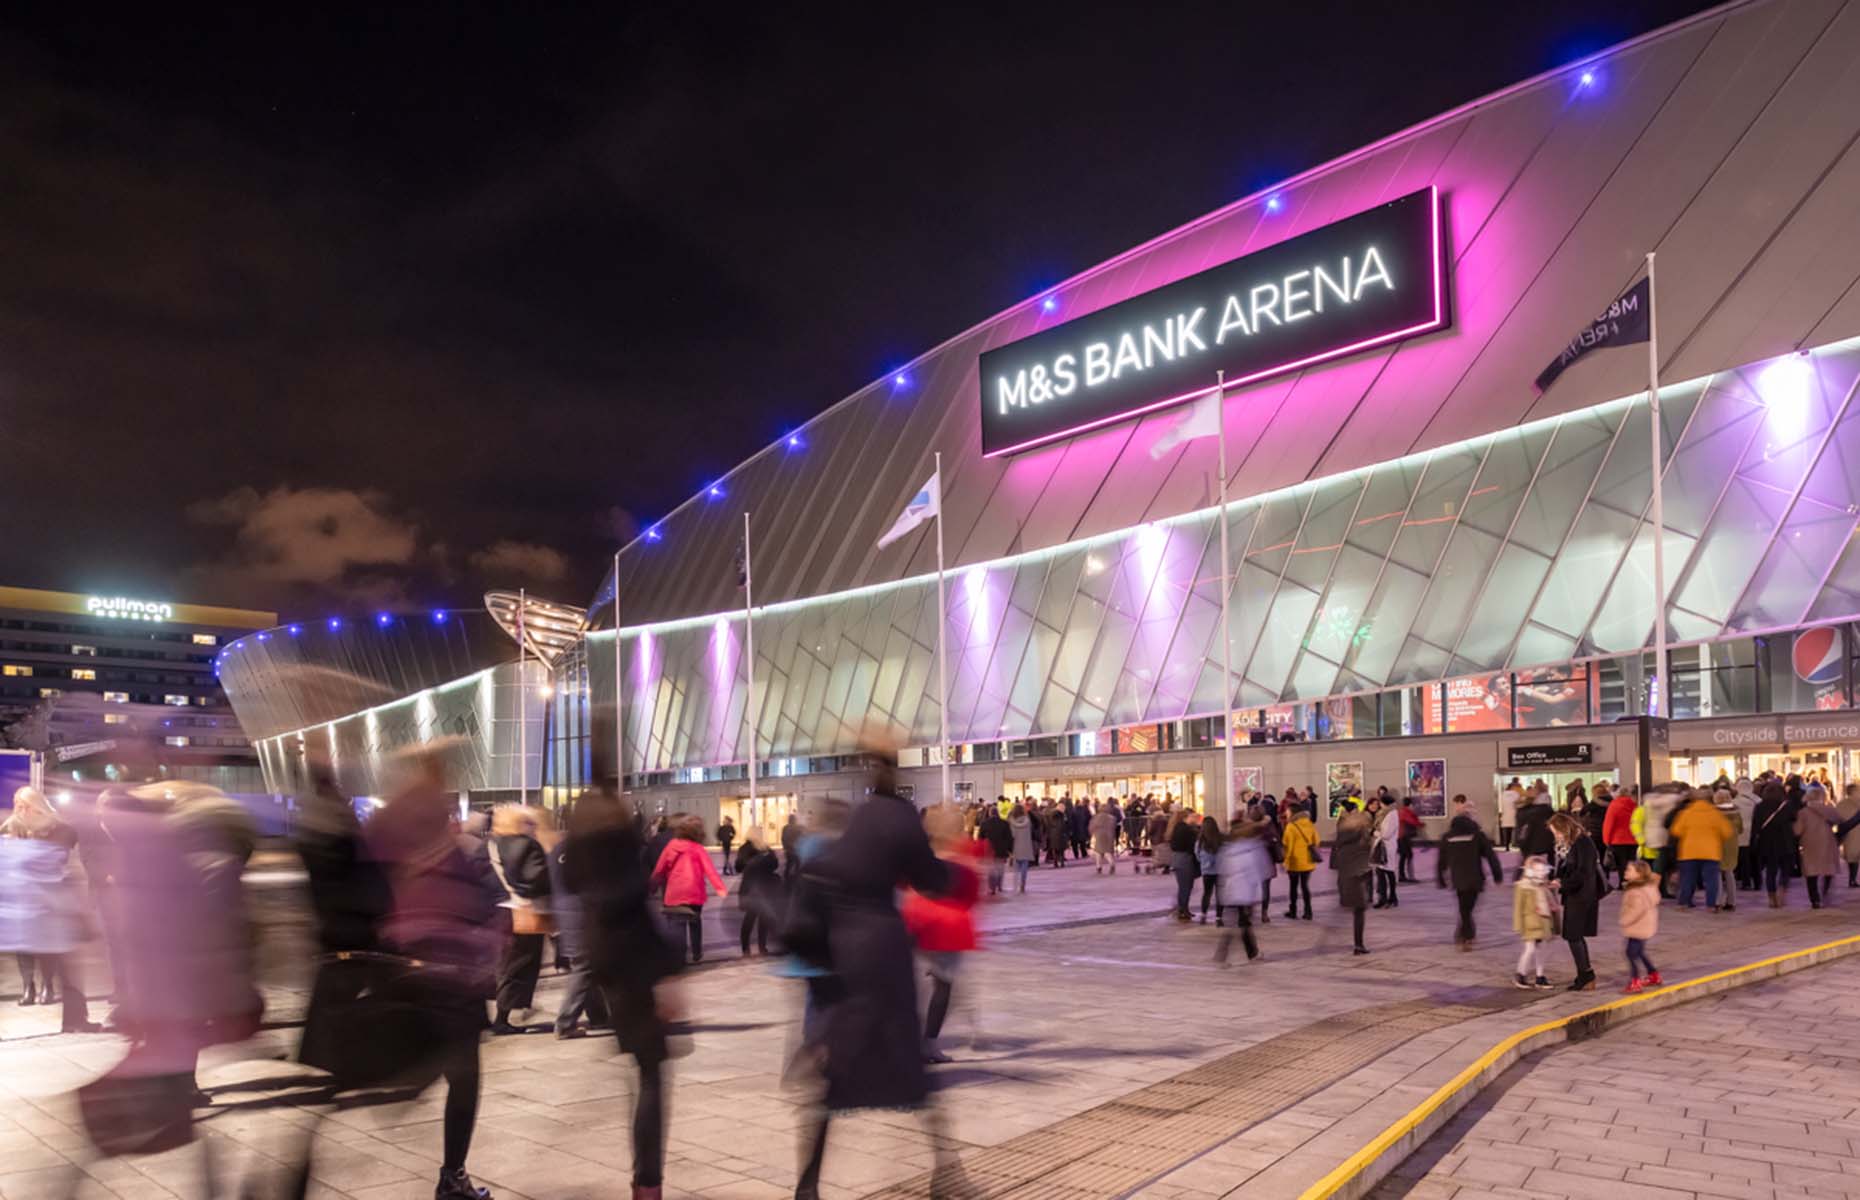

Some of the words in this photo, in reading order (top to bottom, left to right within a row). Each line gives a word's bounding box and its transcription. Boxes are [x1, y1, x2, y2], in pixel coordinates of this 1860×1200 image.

[998, 363, 1077, 415] M&S
[1084, 306, 1208, 387] BANK
[1214, 245, 1394, 346] ARENA
[87, 597, 172, 618] pullman
[1431, 686, 1484, 700] MMORIES
[1713, 729, 1778, 744] Cityside
[1784, 725, 1859, 740] Entrance
